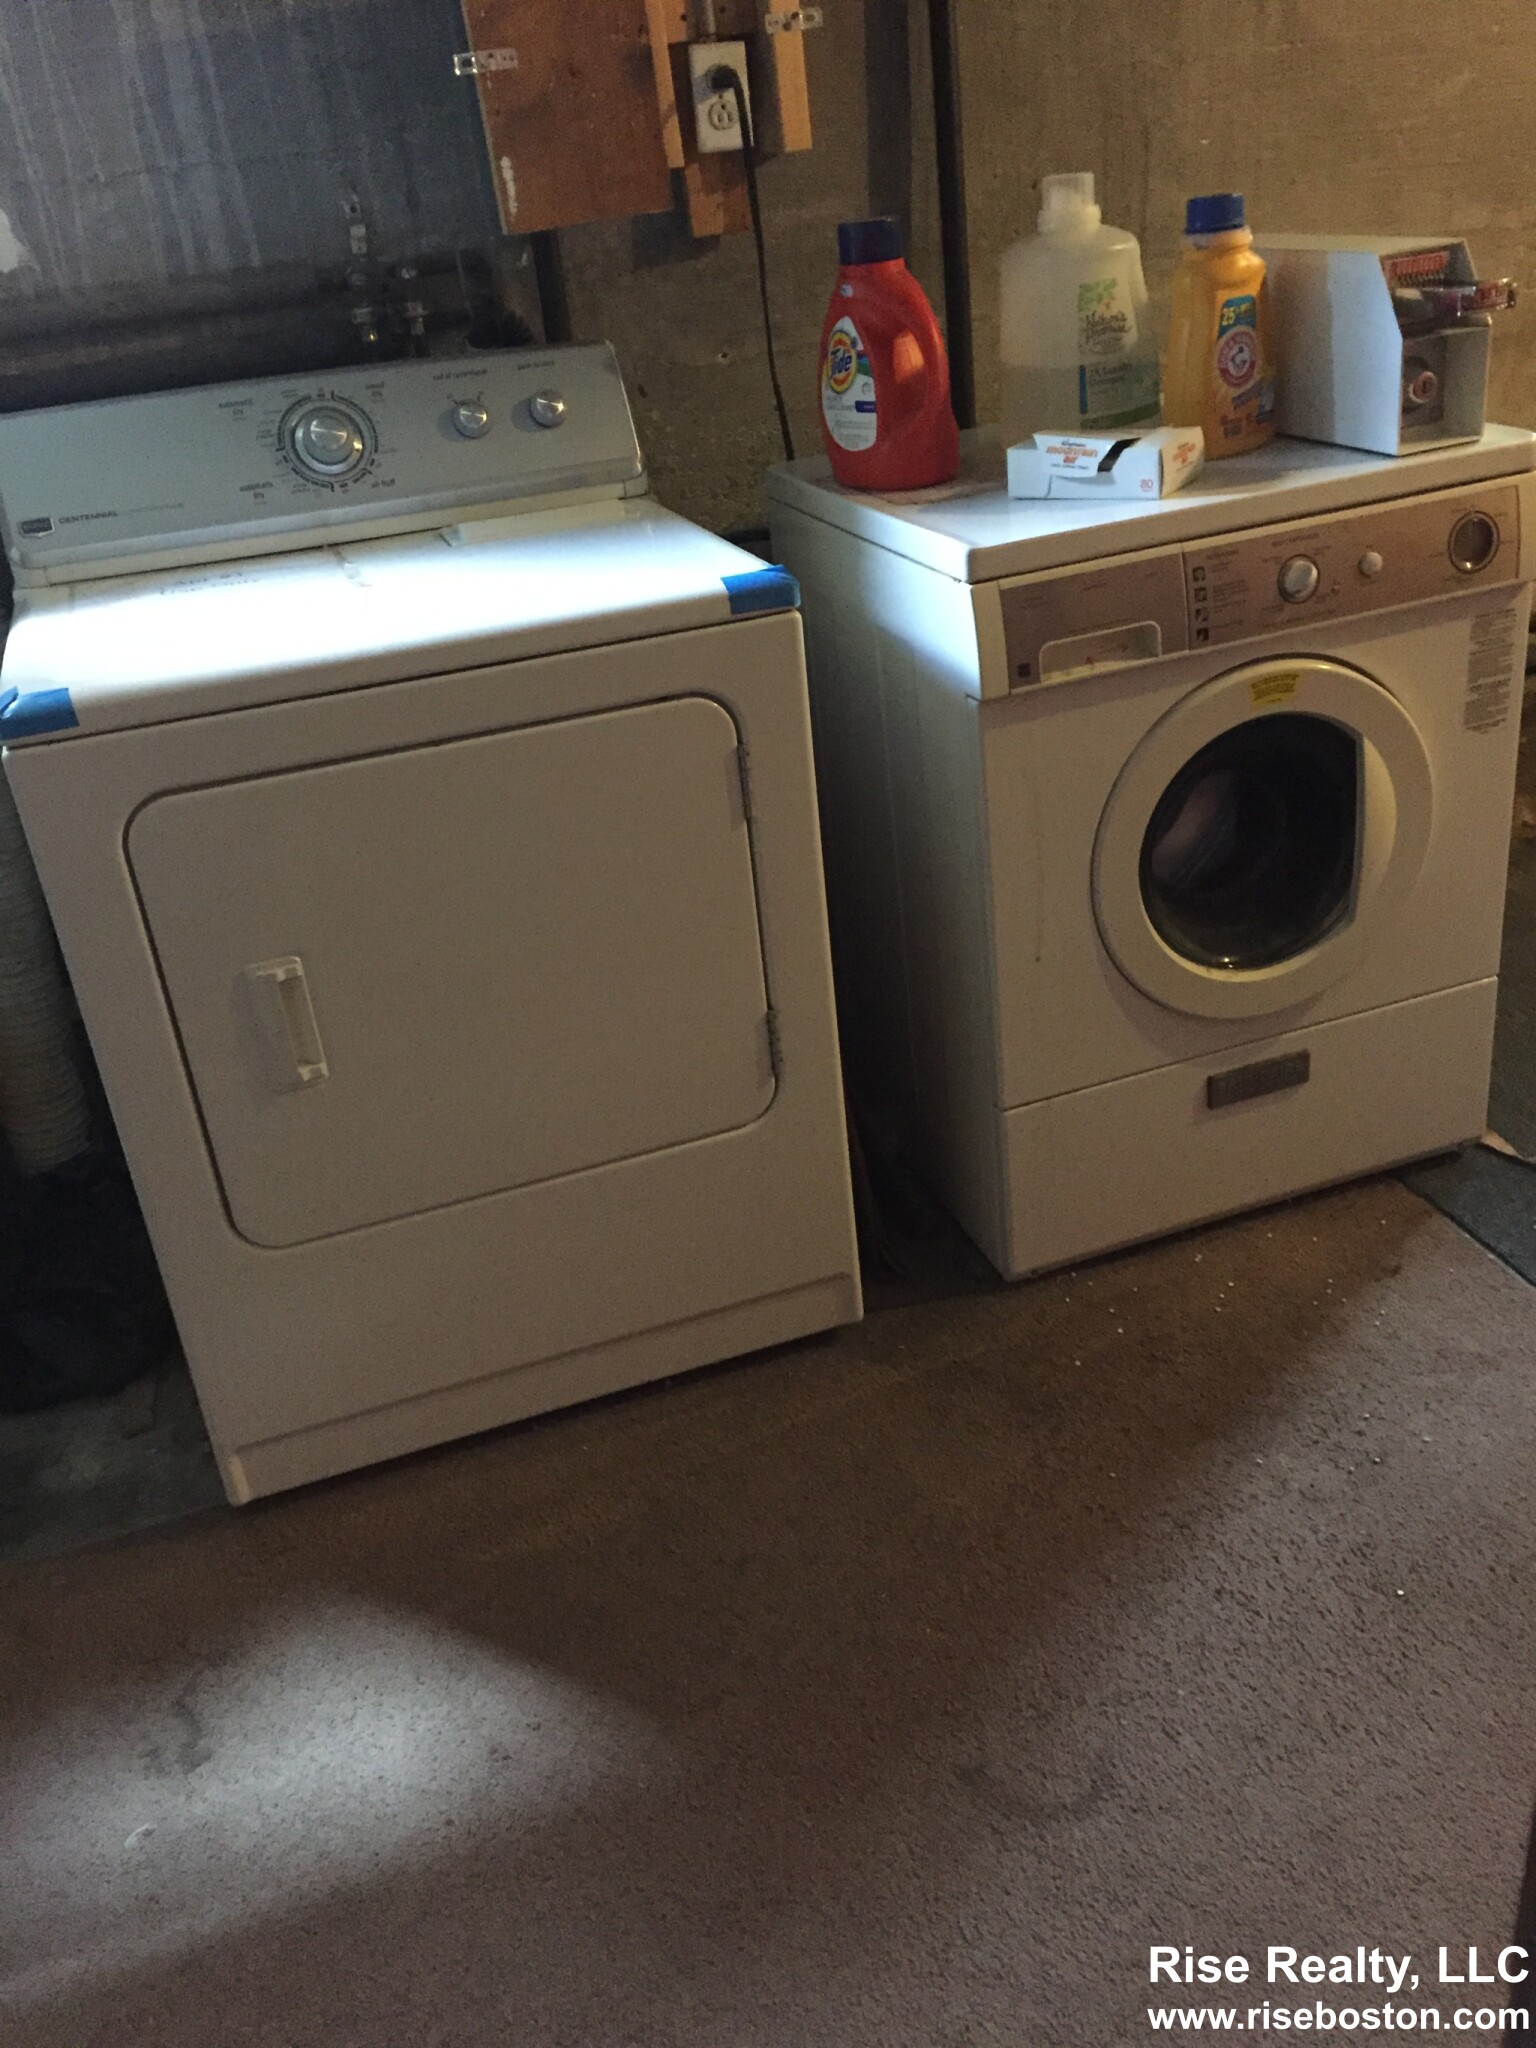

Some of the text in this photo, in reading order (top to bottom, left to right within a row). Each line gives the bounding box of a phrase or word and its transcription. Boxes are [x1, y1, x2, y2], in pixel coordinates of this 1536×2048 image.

[830, 347, 853, 378] Tide
[1046, 446, 1098, 458] mountain
[1140, 478, 1154, 490] 80
[58, 510, 118, 524] CENTENNIAL
